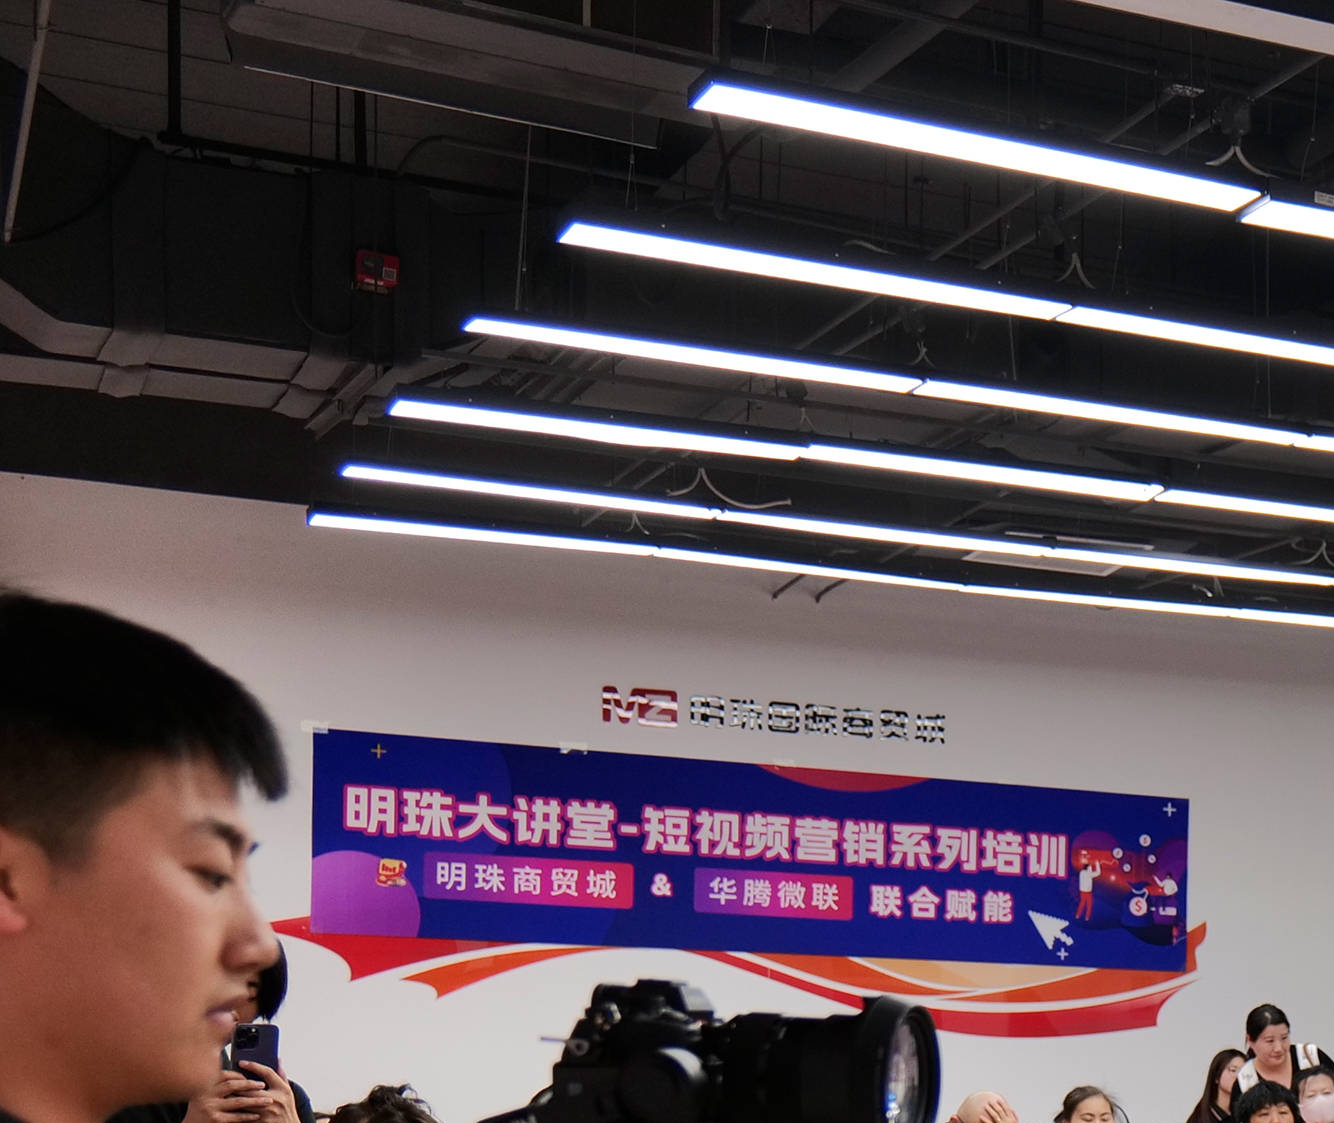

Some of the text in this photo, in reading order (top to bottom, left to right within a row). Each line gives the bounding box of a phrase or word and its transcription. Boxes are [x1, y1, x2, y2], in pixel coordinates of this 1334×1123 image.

[344, 783, 1068, 879] 明珠大讲堂-短视频营销系列培训
[435, 860, 1015, 925] 明珠商贸城 & 华腾微联 联合赋能
